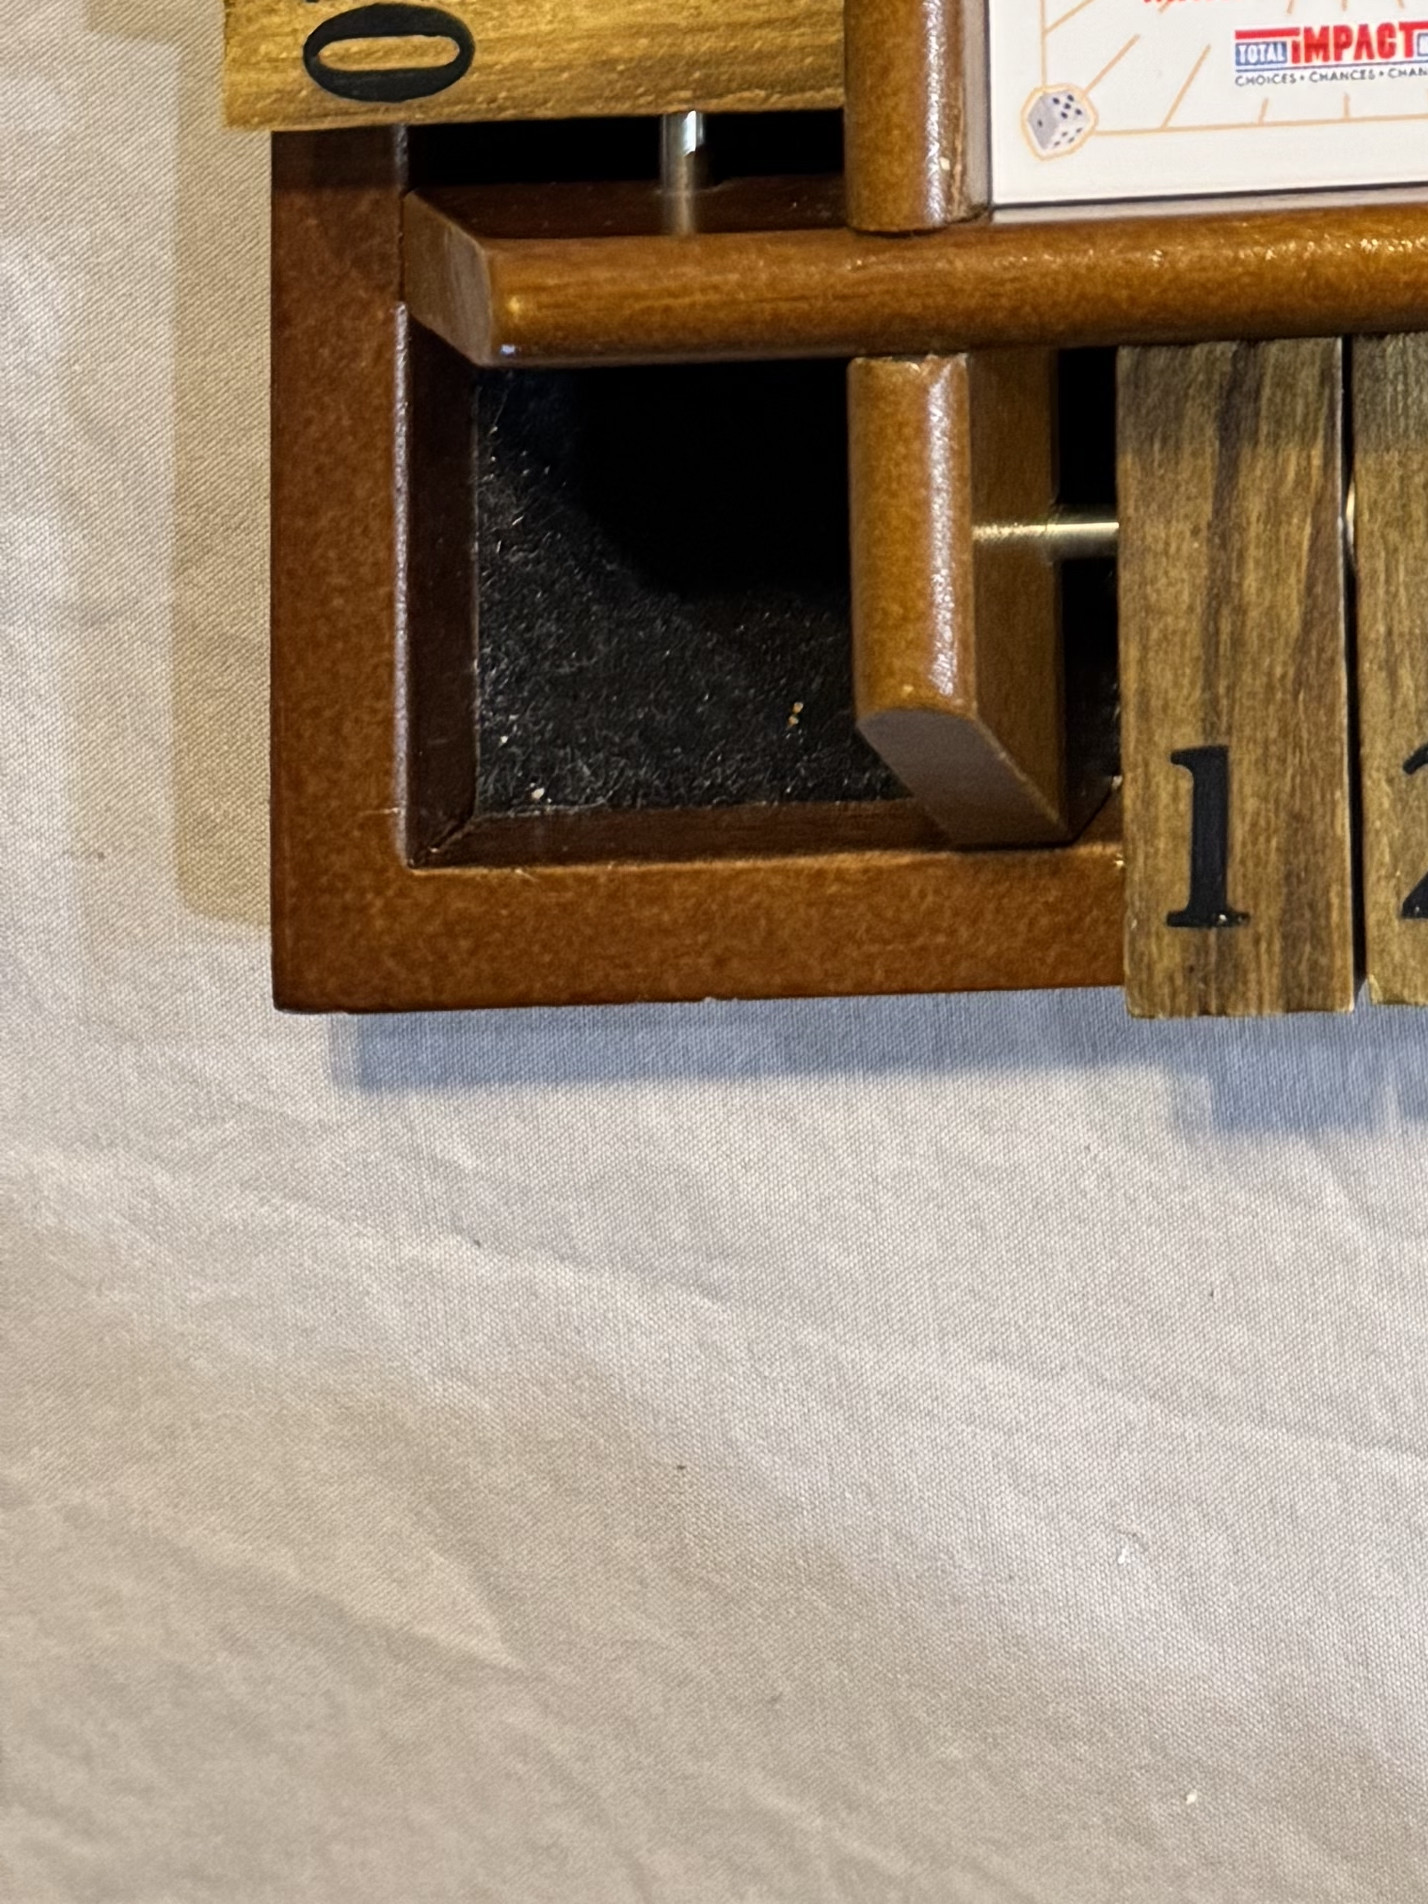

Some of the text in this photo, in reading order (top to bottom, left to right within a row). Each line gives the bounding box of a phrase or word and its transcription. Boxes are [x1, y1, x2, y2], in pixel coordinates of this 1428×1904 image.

[1236, 42, 1287, 64] TOTAL
[1235, 72, 1297, 87] CHOICES
[1308, 69, 1376, 83] CHANCES
[1165, 744, 1249, 929] 1
